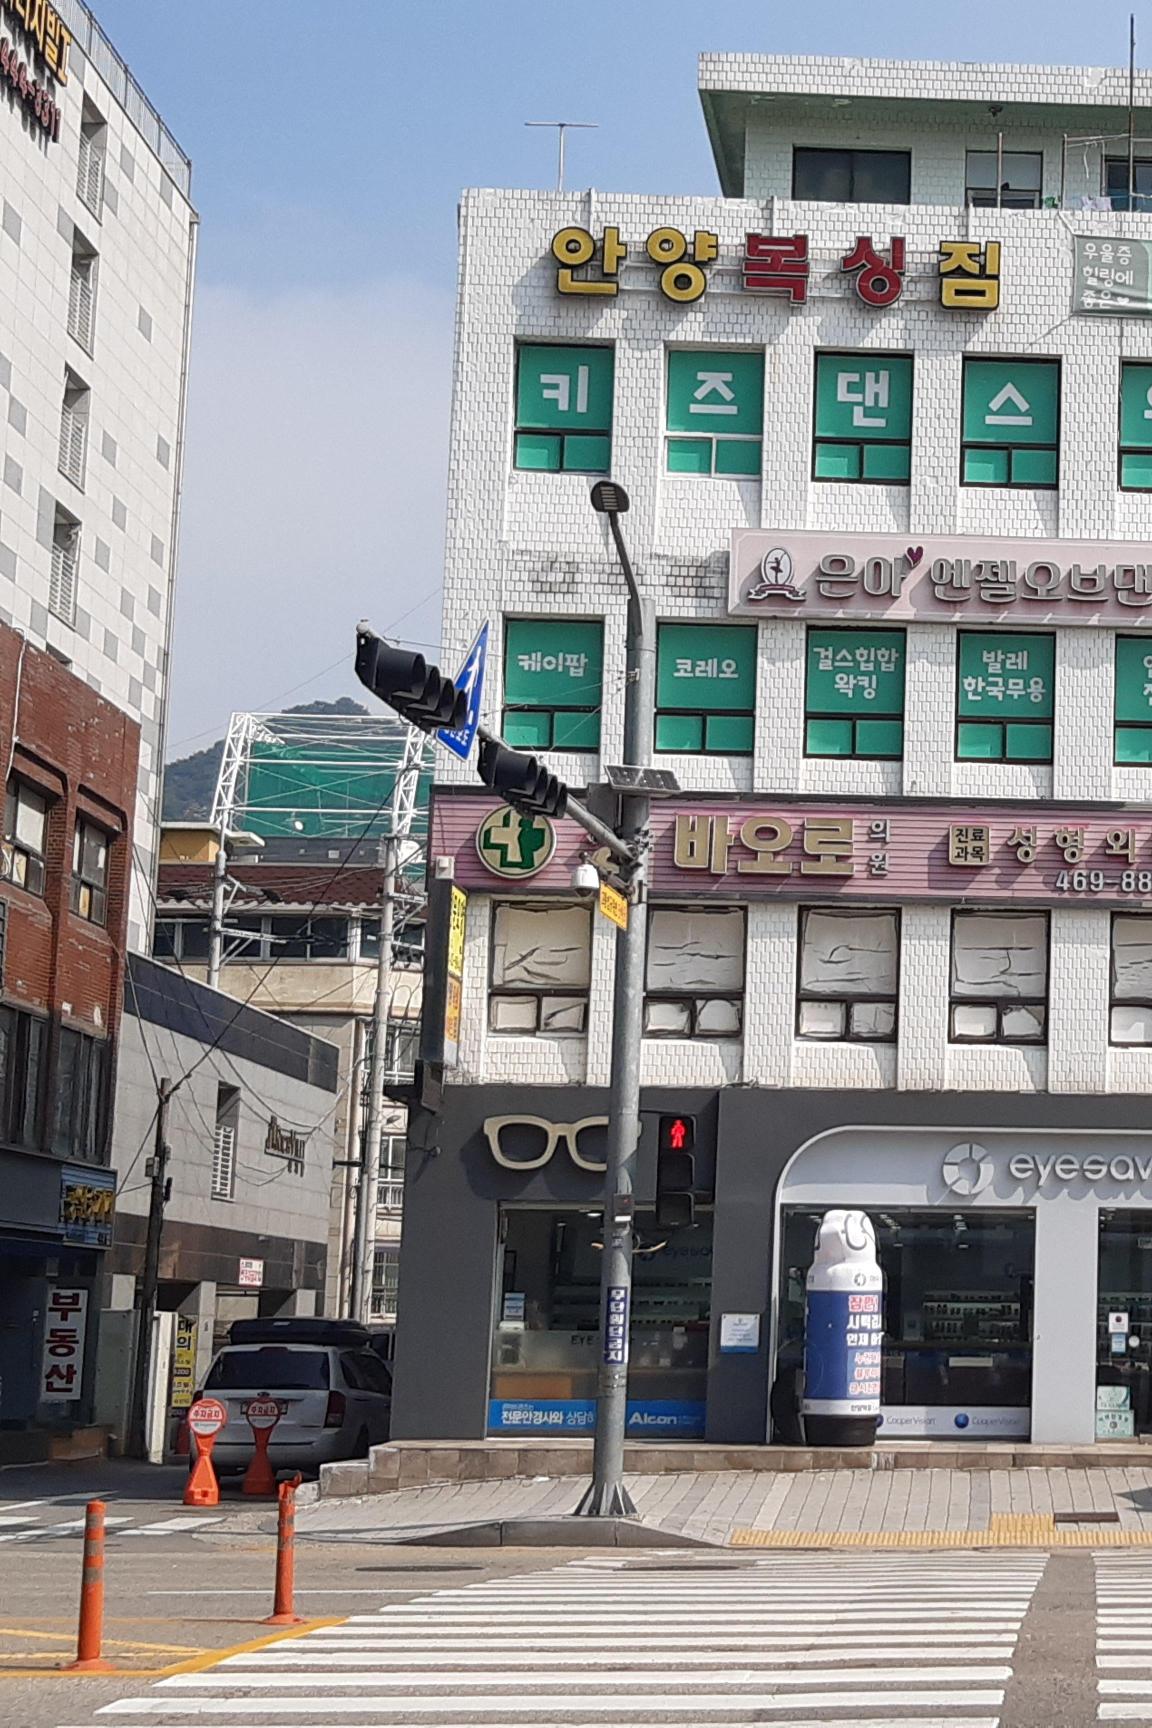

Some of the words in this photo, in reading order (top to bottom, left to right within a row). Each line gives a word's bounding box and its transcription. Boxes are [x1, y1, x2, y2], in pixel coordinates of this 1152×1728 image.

[1083, 243, 1132, 265] 우울증
[1083, 266, 1134, 287] 힐링에
[1081, 289, 1111, 310] 좋은
[815, 552, 905, 599] 은아
[517, 651, 588, 678] 케이팝
[673, 657, 739, 680] 코레오
[814, 646, 898, 672] 걸스힙합
[981, 650, 1029, 674] 발레
[834, 673, 878, 699] 왁킹
[963, 675, 1046, 702] 한국무용
[674, 814, 856, 876] 바오로
[869, 818, 890, 876] 의원
[955, 828, 985, 842] 진료
[954, 846, 985, 861] 과목
[46, 1293, 82, 1393] 부동산
[193, 1409, 220, 1419] 주차금지
[251, 1405, 275, 1415] 주차금지
[629, 1411, 677, 1425] Alcon
[887, 1416, 936, 1426] CooperVision
